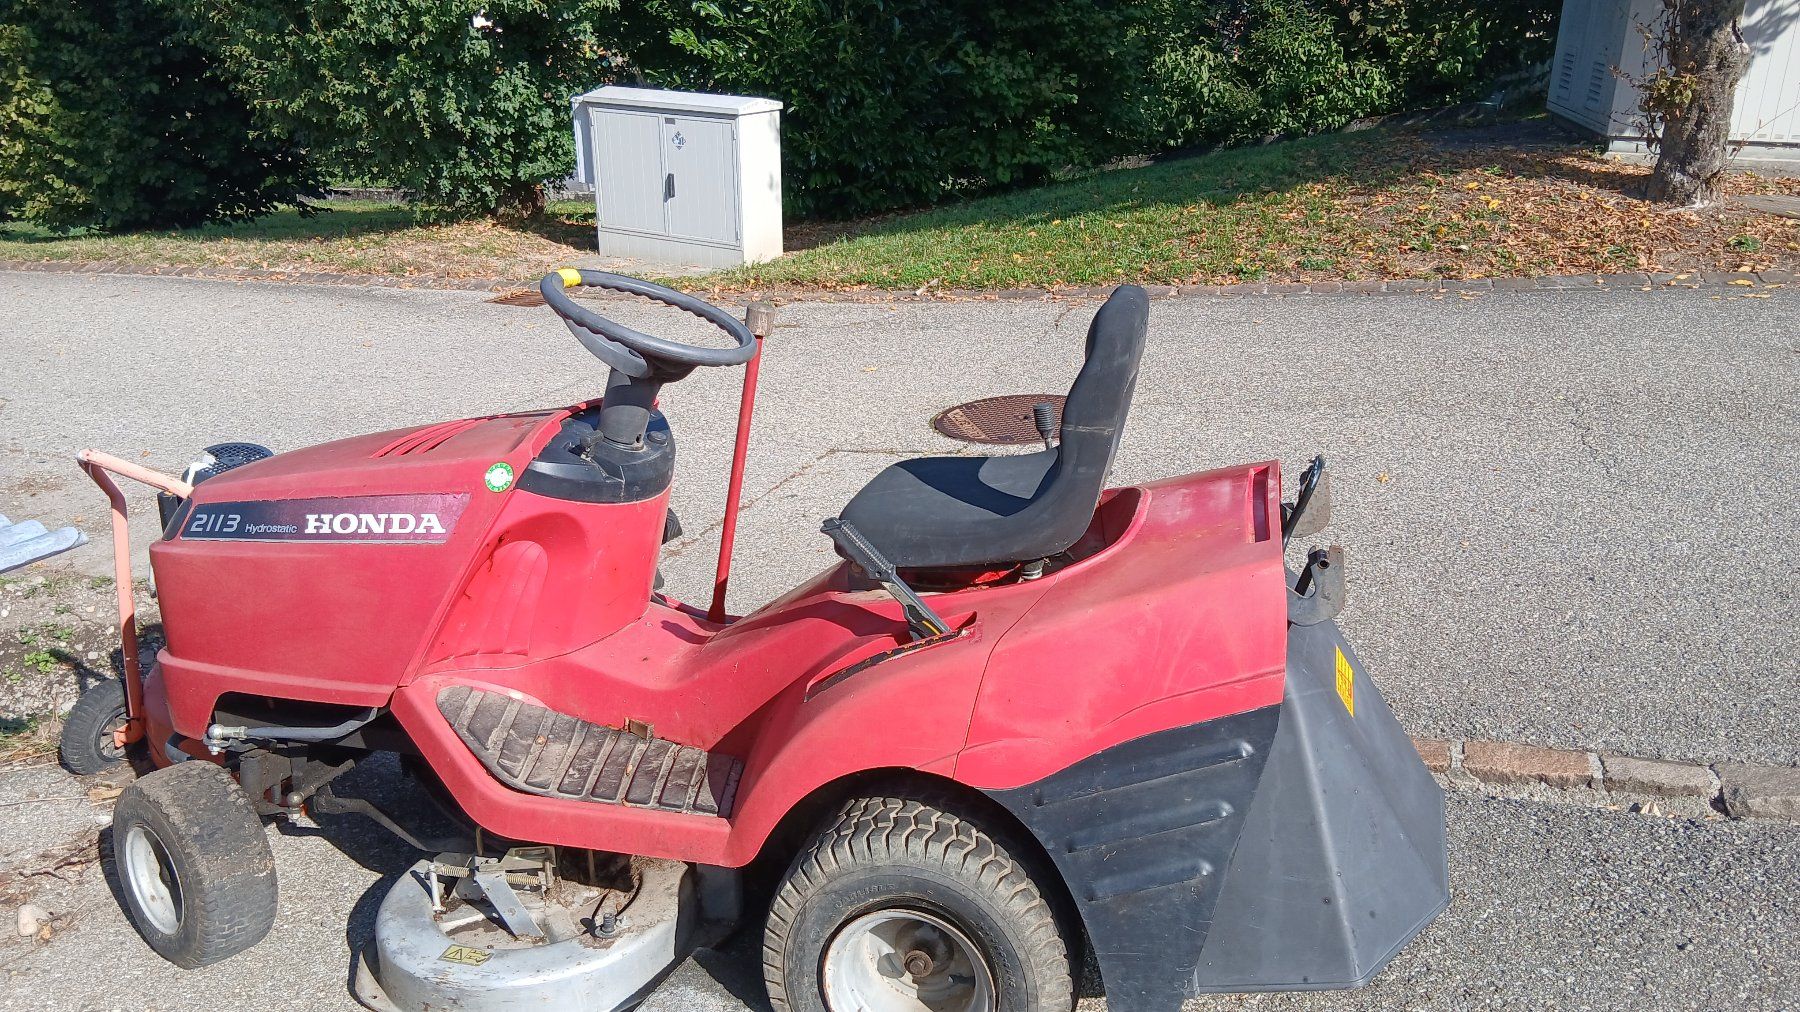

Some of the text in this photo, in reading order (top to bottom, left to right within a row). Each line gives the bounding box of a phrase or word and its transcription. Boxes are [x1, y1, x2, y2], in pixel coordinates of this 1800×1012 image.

[190, 513, 447, 534] 2113 Hydrostatic HONDA
